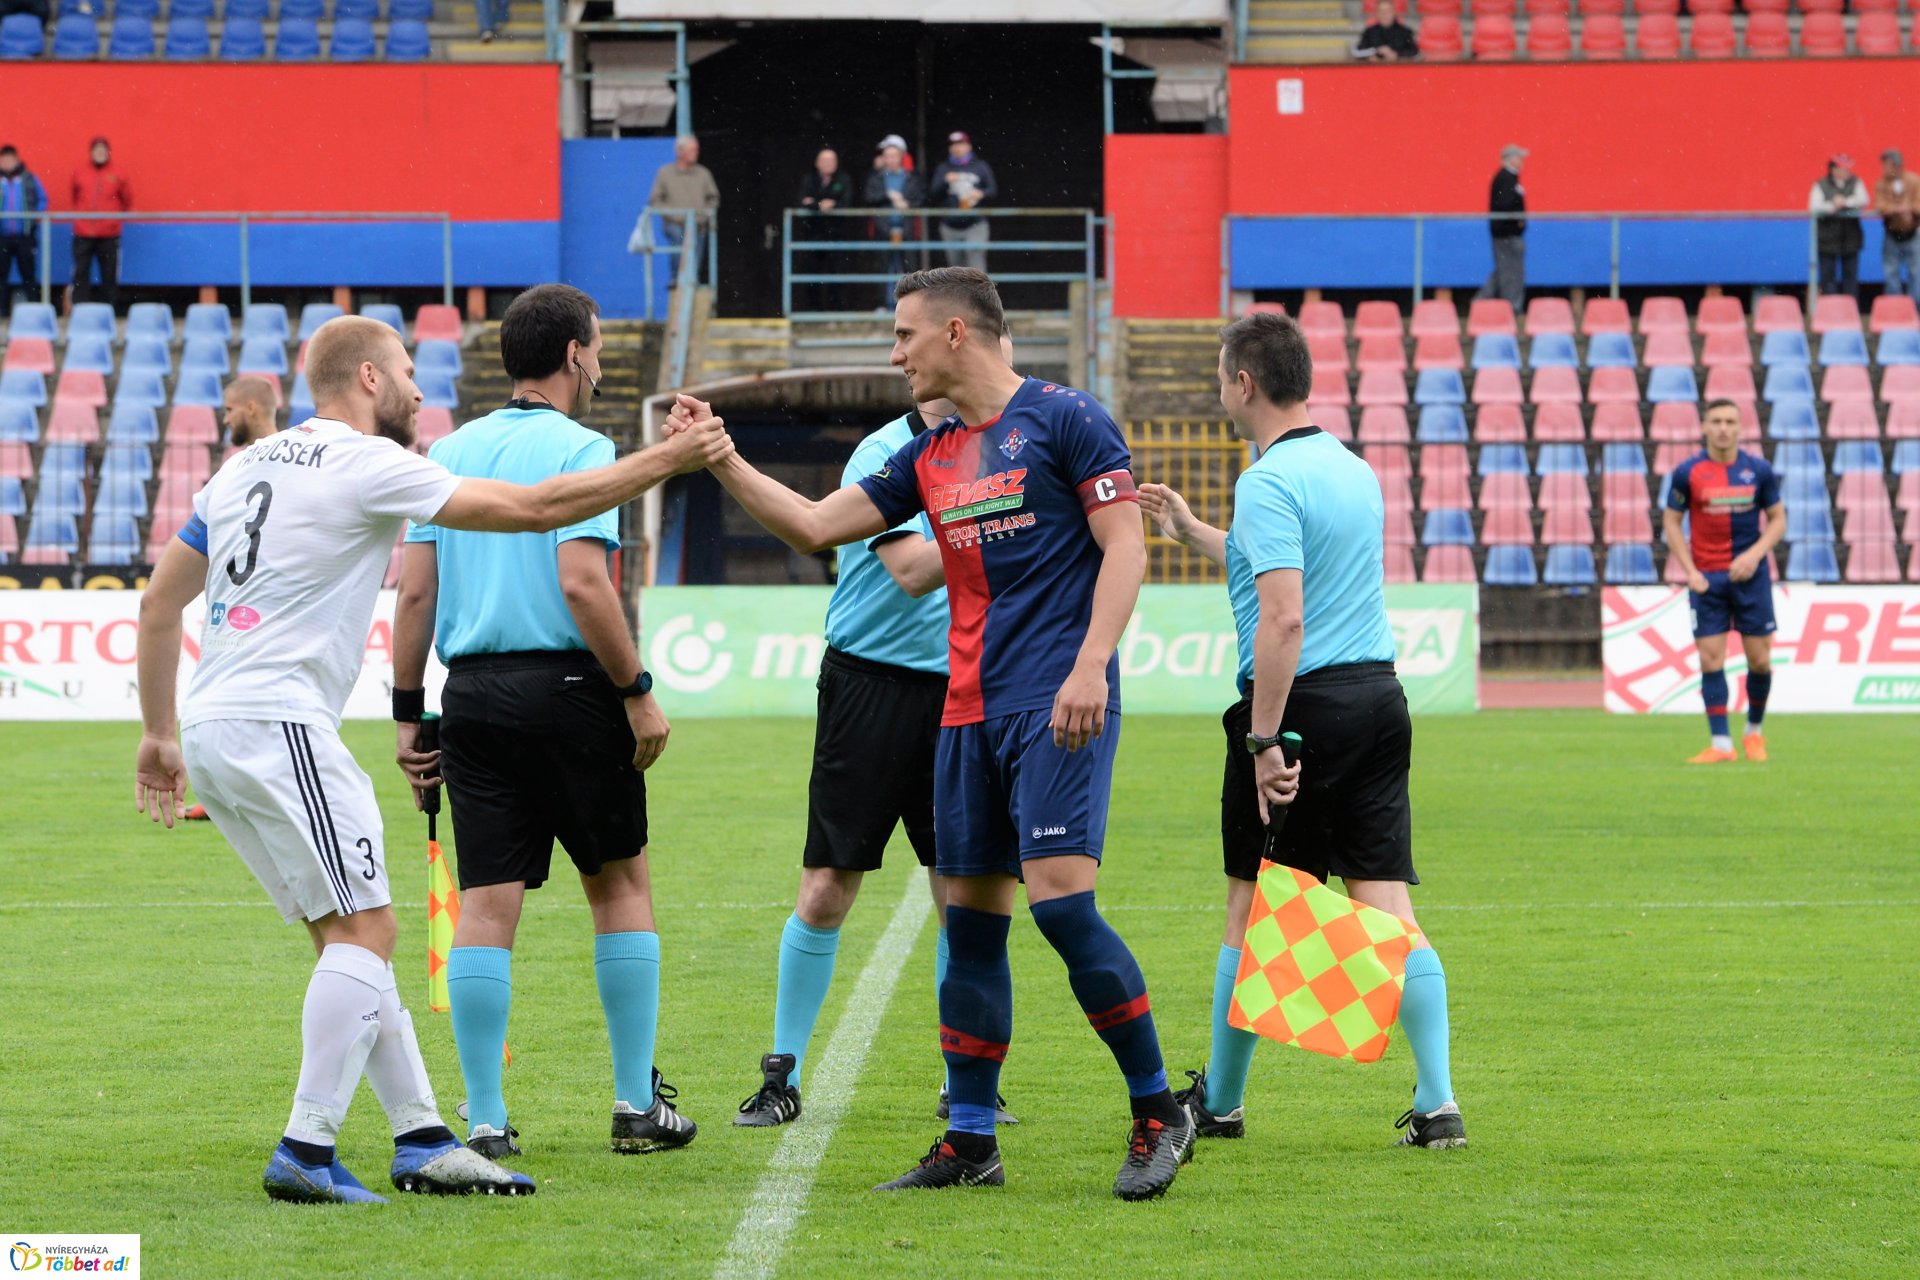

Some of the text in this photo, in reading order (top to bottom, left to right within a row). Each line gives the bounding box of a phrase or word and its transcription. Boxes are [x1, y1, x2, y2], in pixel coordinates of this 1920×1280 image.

[1094, 477, 1117, 502] C
[942, 498, 1020, 521] ALWAYS ON THE RIGHT WAY
[226, 480, 273, 587] 3
[981, 512, 1036, 535] TRANS
[1043, 826, 1067, 836] JAKO
[356, 837, 377, 881] 3
